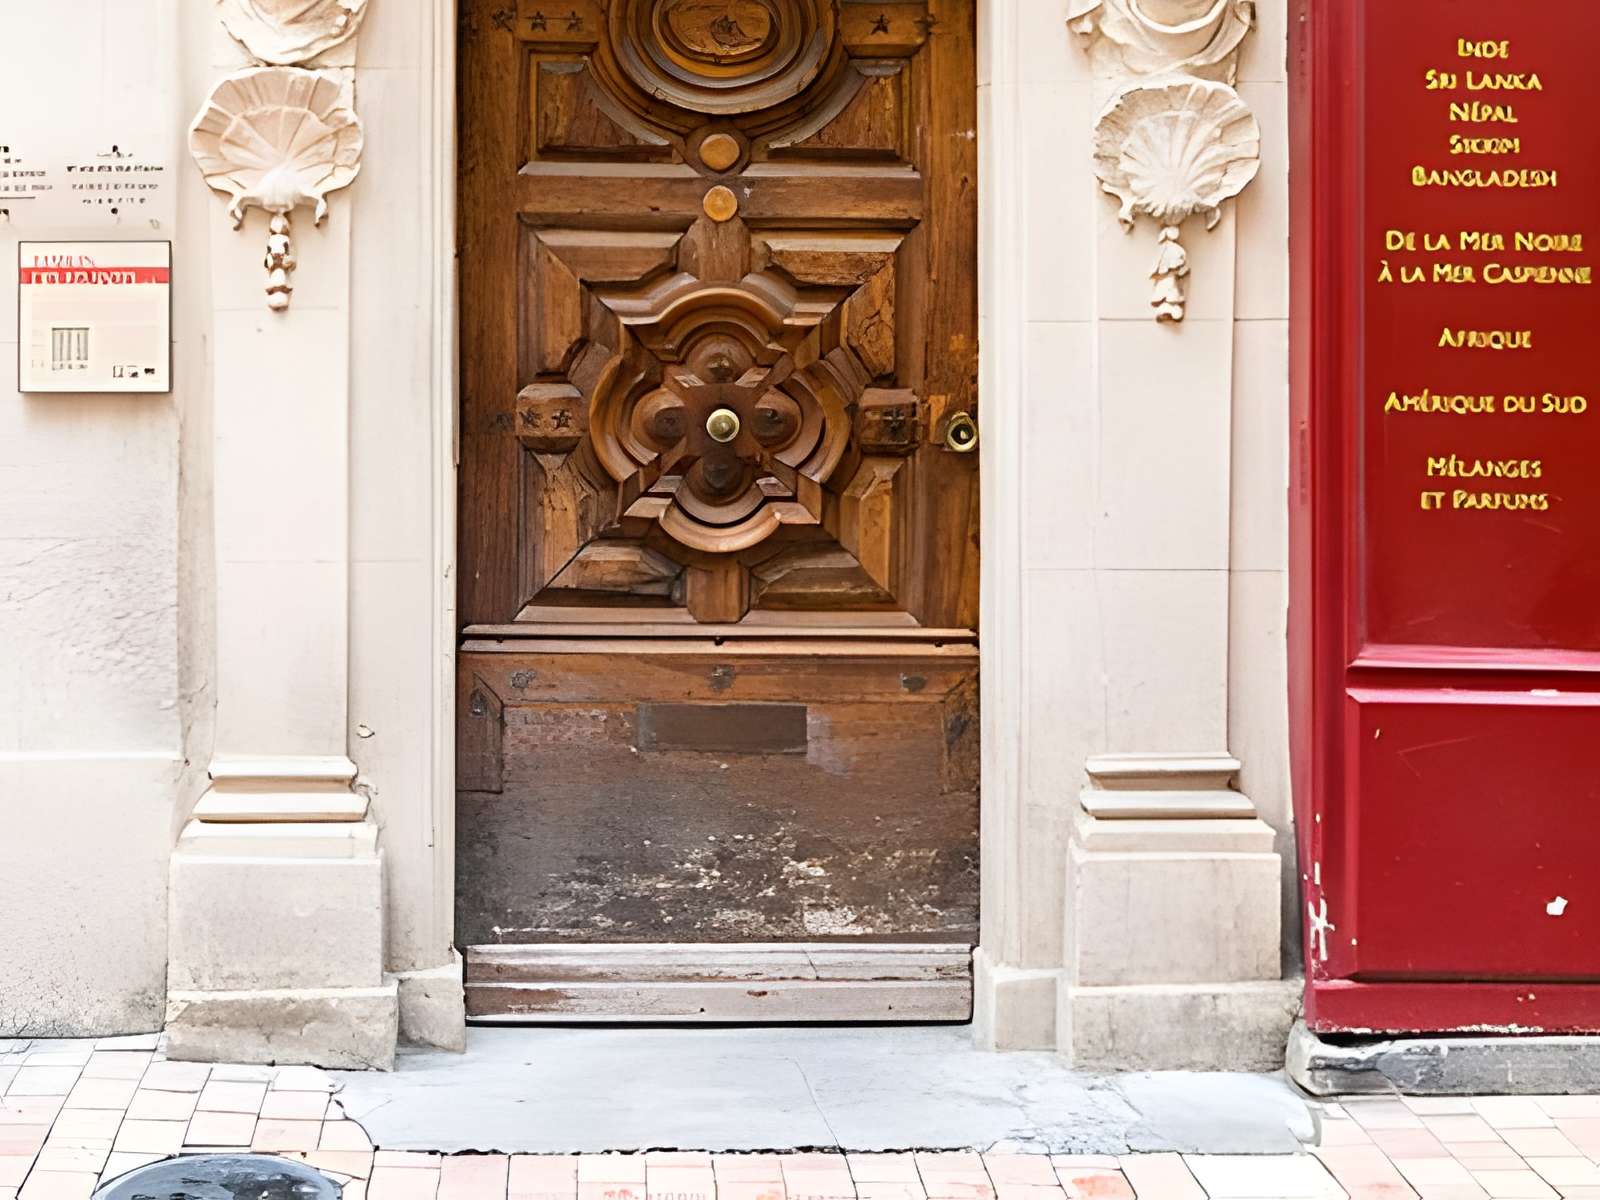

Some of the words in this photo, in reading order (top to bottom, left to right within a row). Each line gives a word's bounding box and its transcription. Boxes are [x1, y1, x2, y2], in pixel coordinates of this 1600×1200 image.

[1458, 39, 1508, 58] INDE
[1467, 71, 1542, 90] LANKA
[1450, 101, 1518, 123] NÉPAL
[1386, 231, 1416, 250] DE
[1424, 234, 1451, 250] LA
[1401, 266, 1425, 283] LA
[1504, 396, 1535, 412] DU
[1542, 394, 1586, 413] SUD
[1428, 454, 1541, 478] MÉLANGES
[1421, 492, 1445, 509] ET
